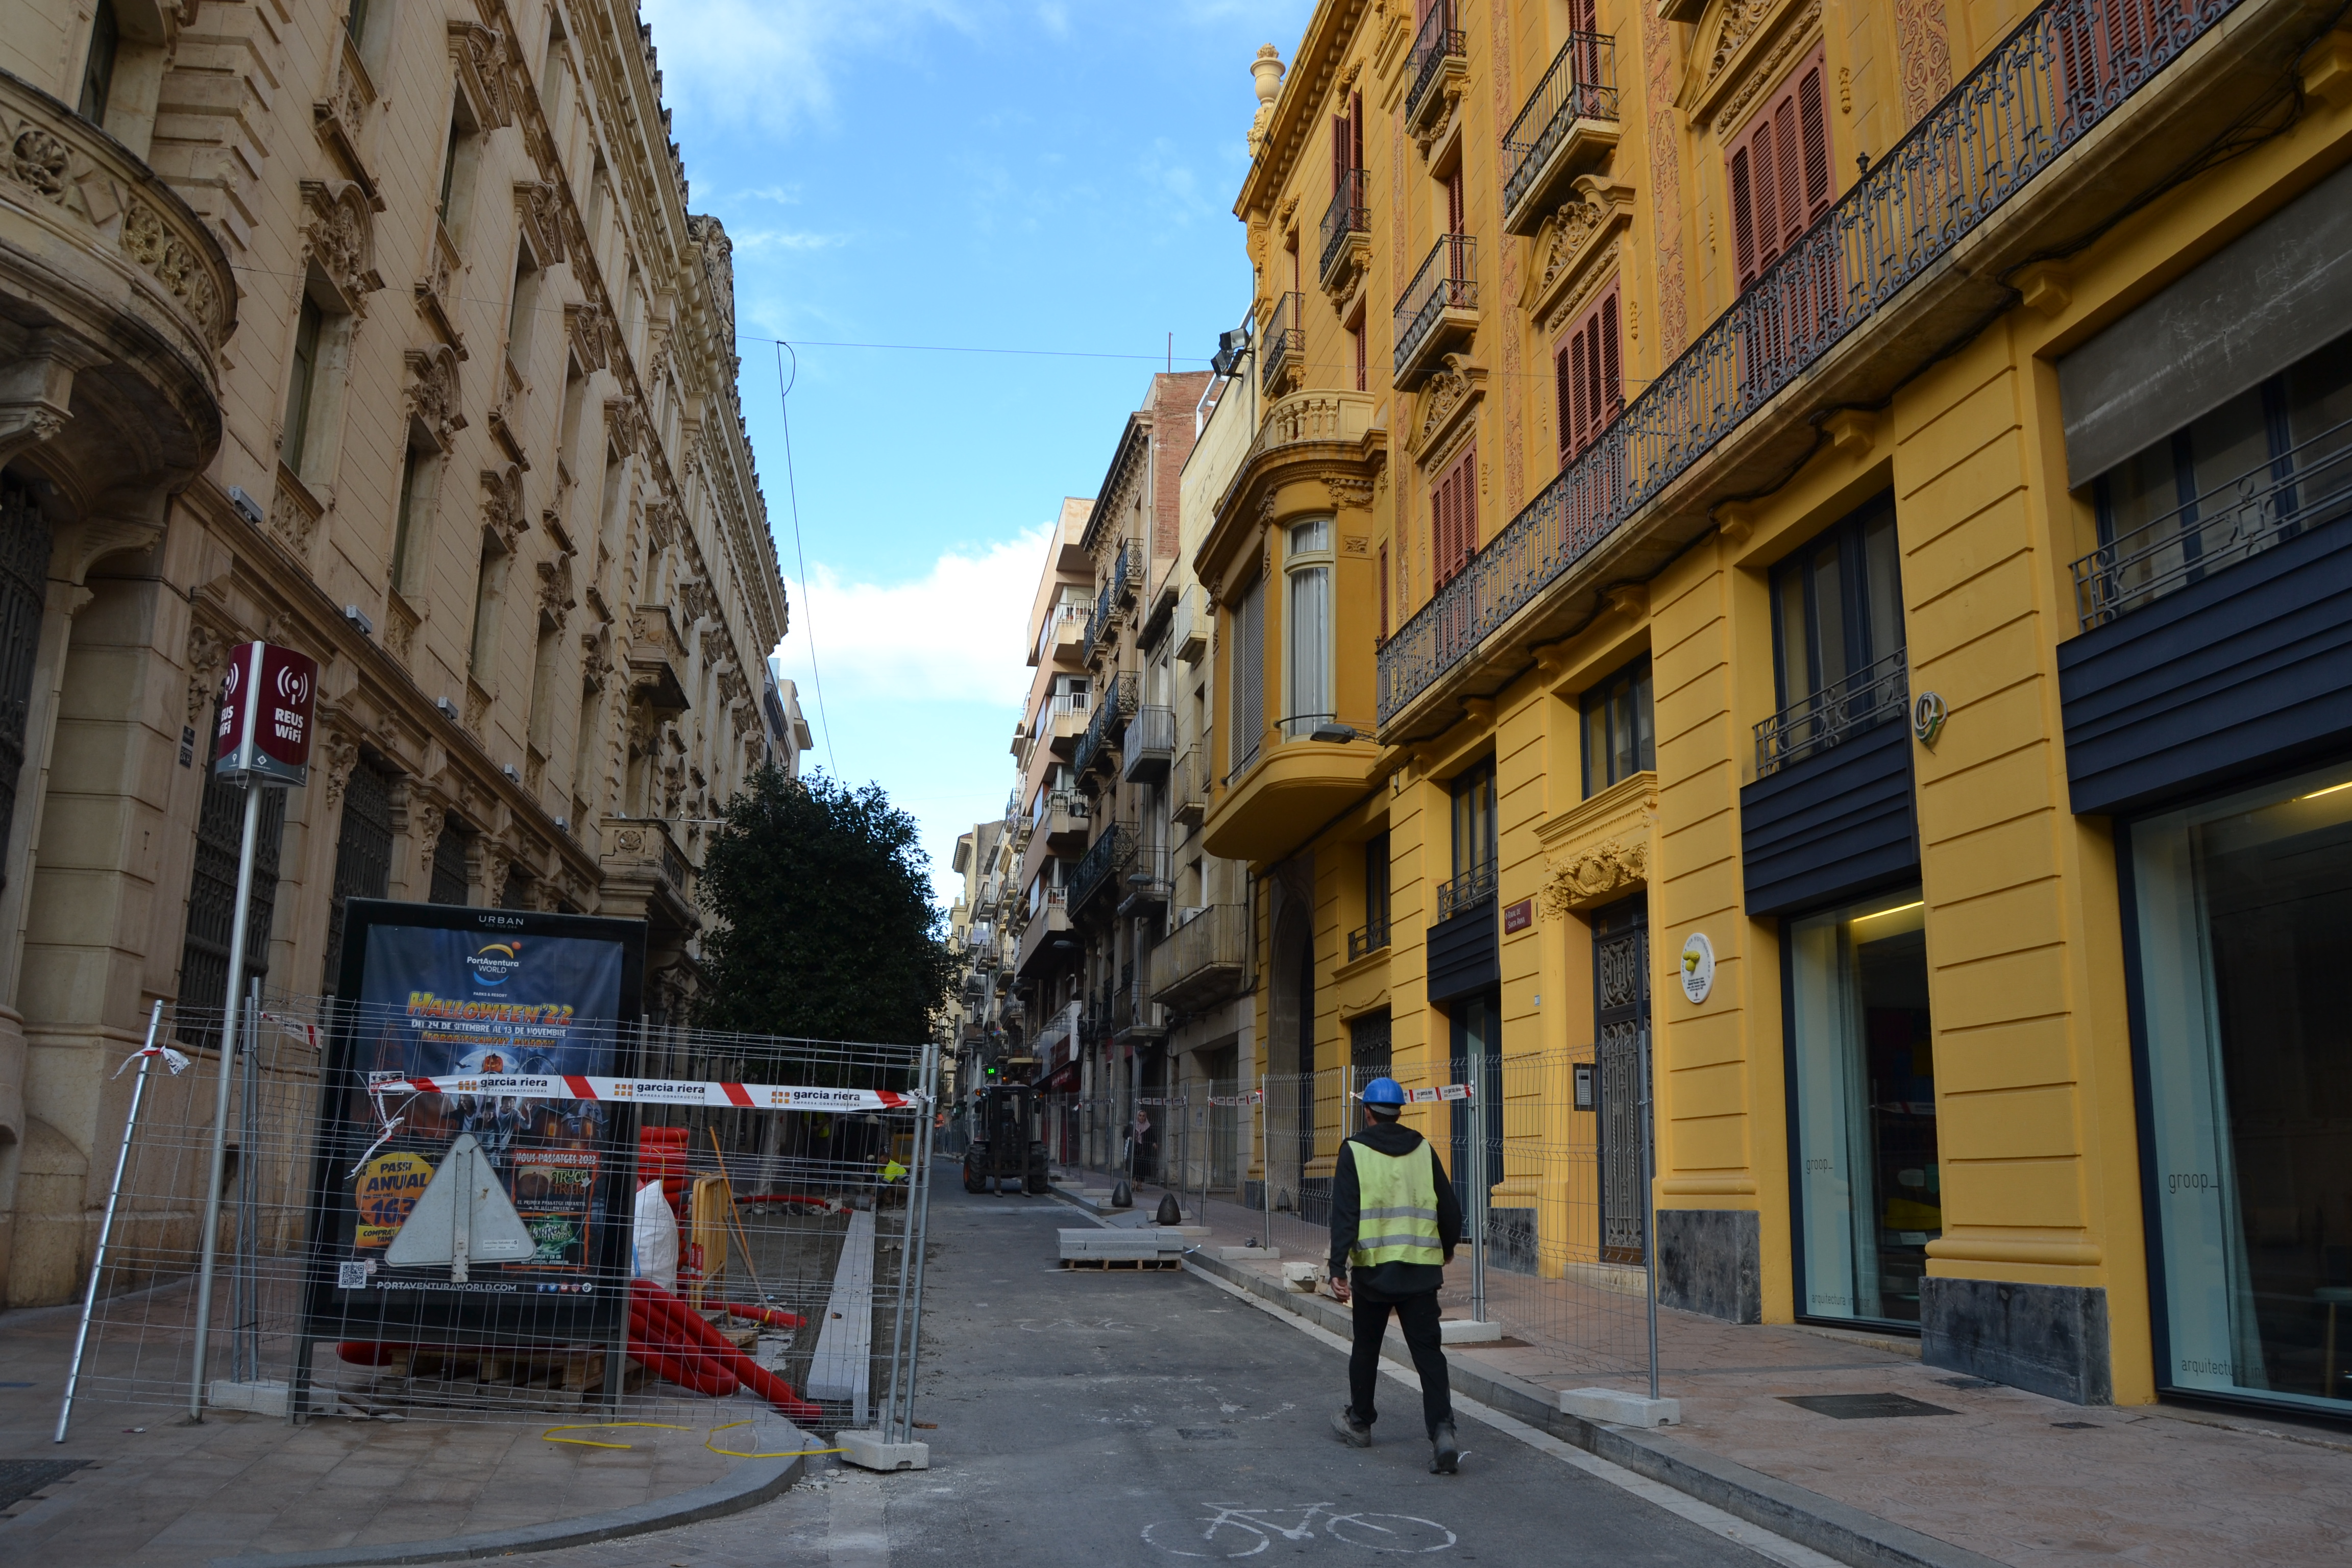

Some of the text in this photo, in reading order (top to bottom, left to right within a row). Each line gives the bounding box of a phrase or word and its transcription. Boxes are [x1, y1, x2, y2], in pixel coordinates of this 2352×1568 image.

[275, 707, 304, 728] REUS
[275, 723, 301, 744] WiFi
[479, 915, 524, 925] URBAN
[467, 957, 519, 967] PortAventura
[479, 965, 507, 973] WORLD
[428, 1020, 439, 1030] 24
[442, 1021, 451, 1030] DE
[504, 1024, 512, 1034] 13
[515, 1025, 524, 1035] DE
[480, 1077, 548, 1088] garcia riera
[636, 1083, 705, 1093] garcia riera
[793, 1090, 861, 1101] garcia riera
[516, 1153, 536, 1163] NOUS
[578, 1155, 596, 1165] 2022
[380, 1162, 412, 1173] PASSI
[1806, 1159, 1833, 1174] groop_
[366, 1173, 428, 1192] ANUAL
[2169, 1173, 2218, 1194] groop_
[377, 1281, 517, 1292] PORTAVENTURAWORLD.COM
[1811, 1293, 1846, 1306] arquitectura
[2182, 1357, 2246, 1378] arquitectura
